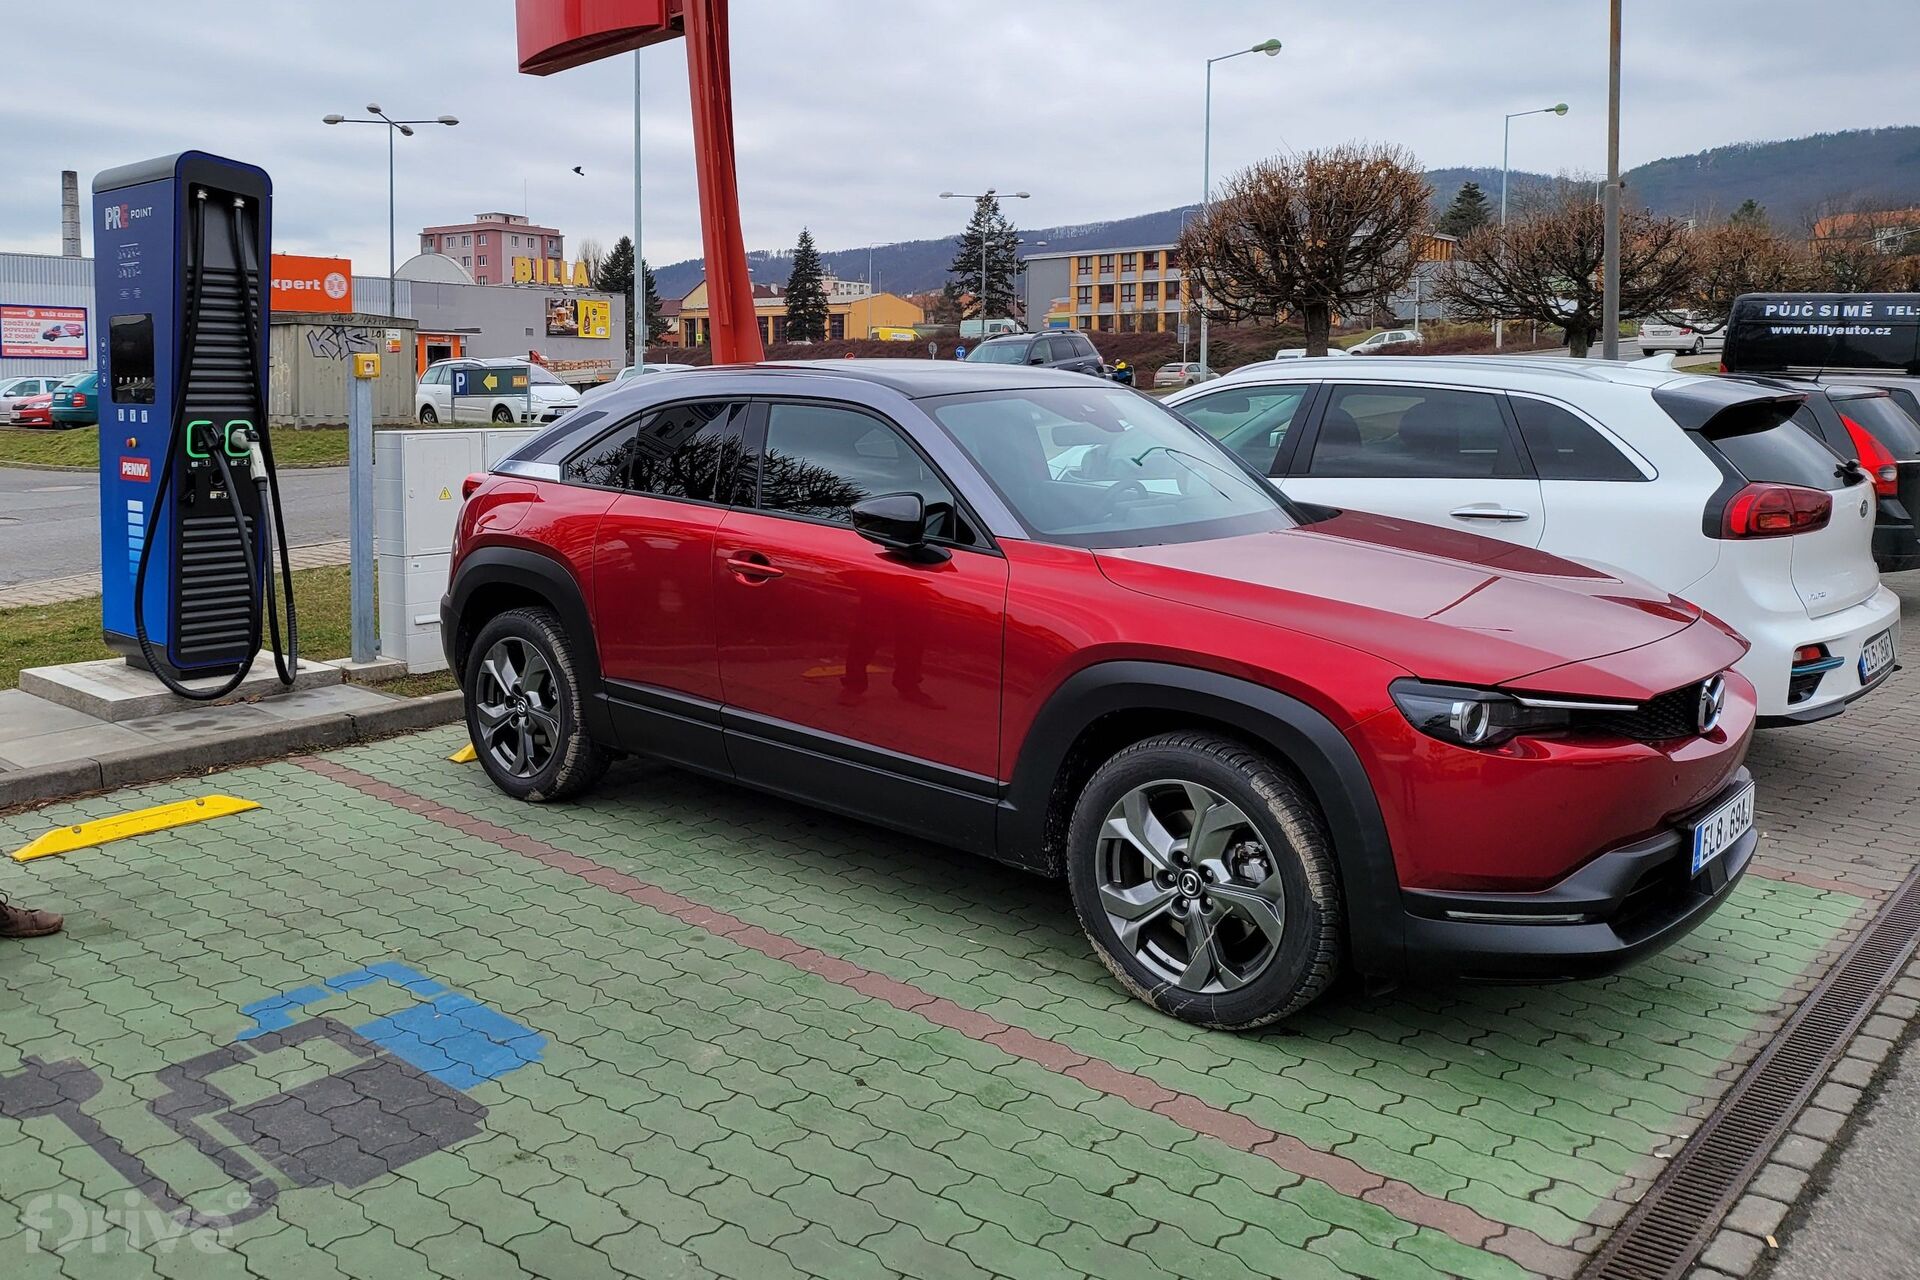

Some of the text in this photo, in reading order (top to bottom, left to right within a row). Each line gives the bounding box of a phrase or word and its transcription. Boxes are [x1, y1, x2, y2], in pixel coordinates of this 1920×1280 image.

[105, 204, 152, 230] PRE POINT
[513, 256, 590, 288] BILLA
[1765, 301, 1814, 317] PŮJČ
[1819, 305, 1839, 316] SI
[1843, 301, 1874, 317] MĚ
[1771, 325, 1892, 337] www.bilyauto.cz
[456, 372, 466, 393] P
[512, 376, 528, 387] BILLA
